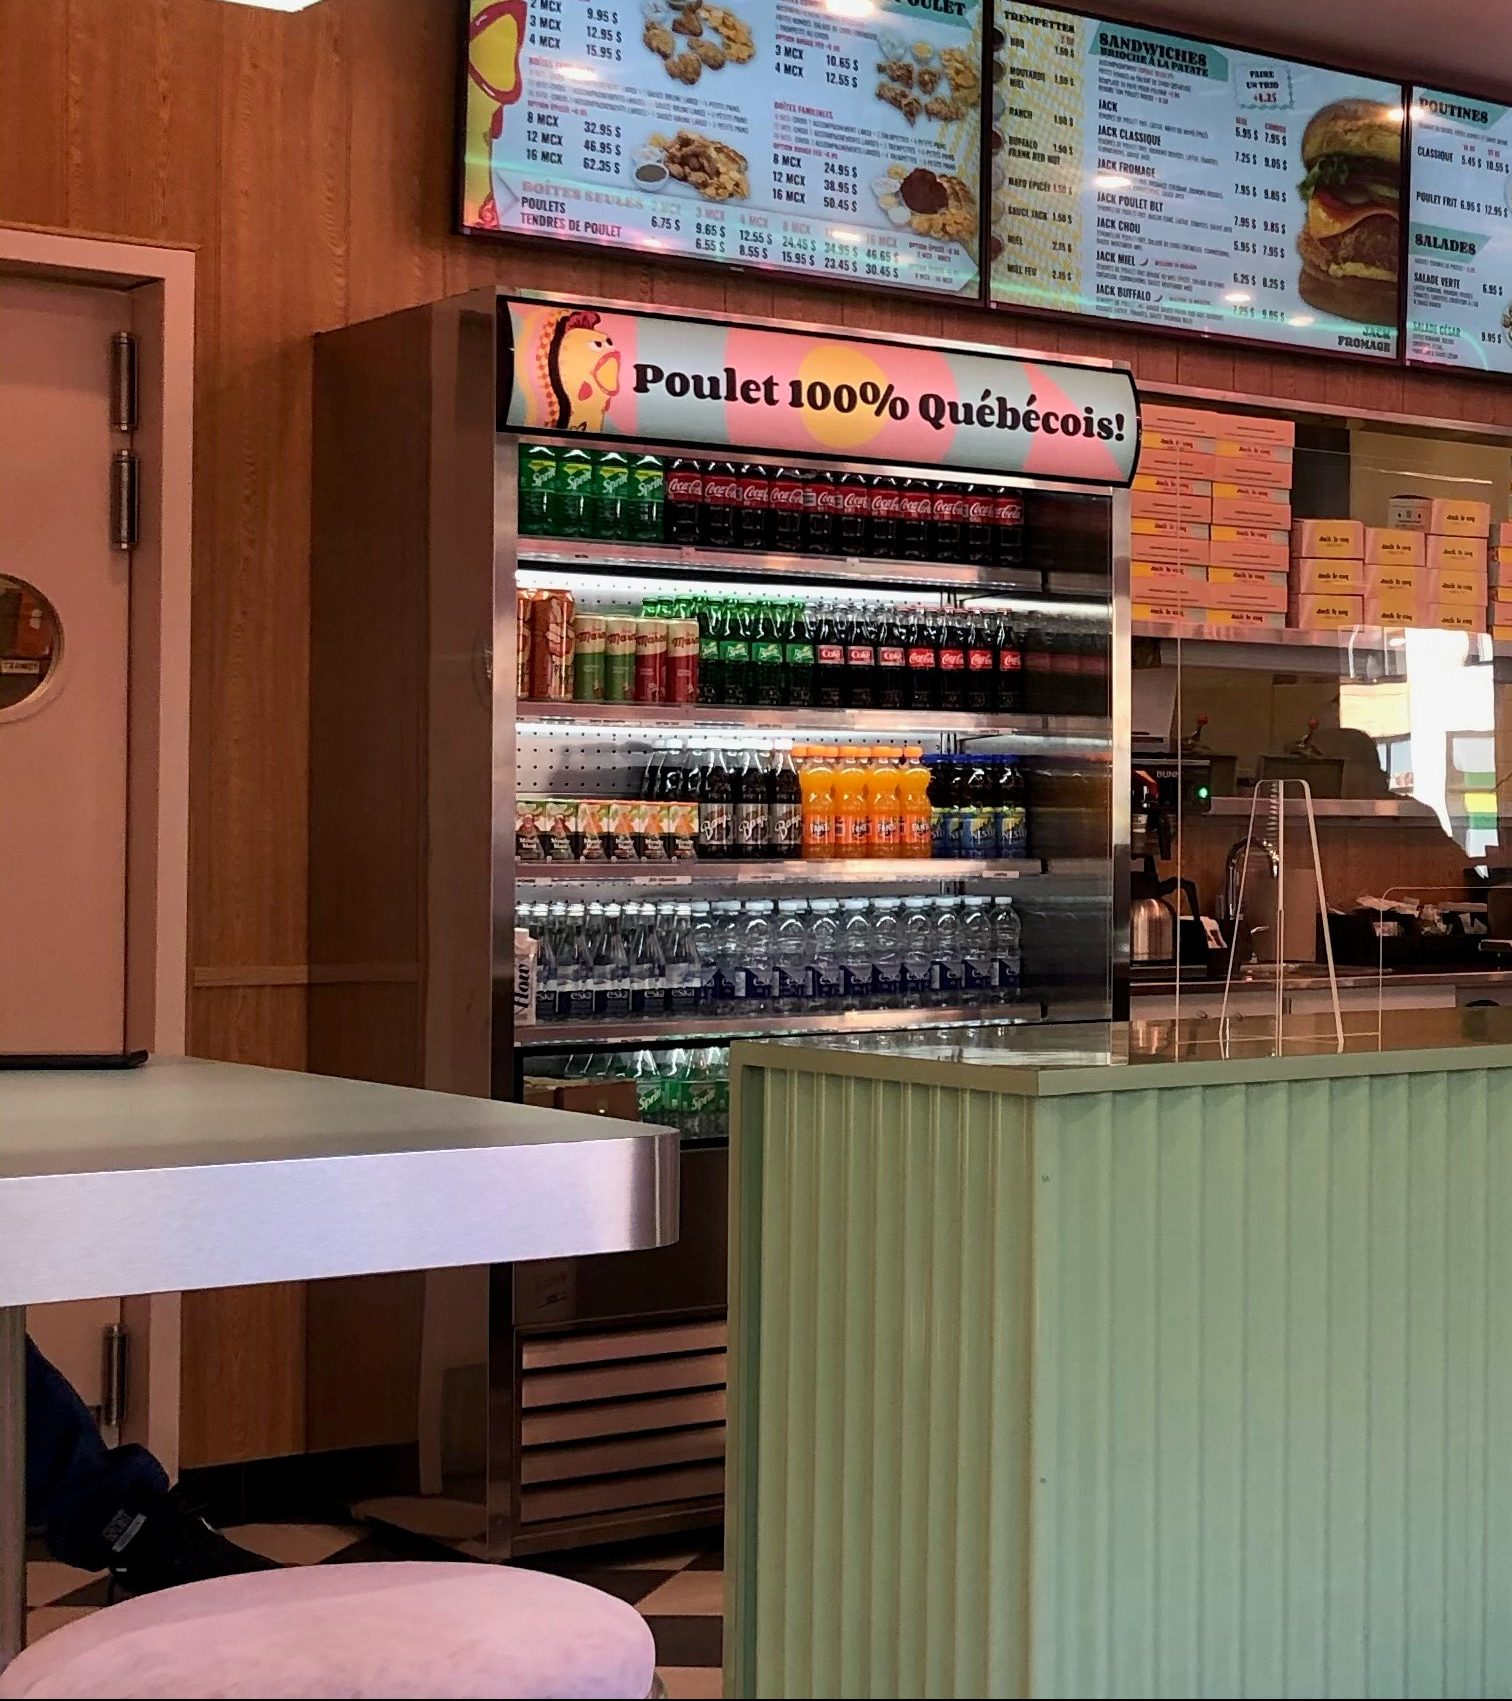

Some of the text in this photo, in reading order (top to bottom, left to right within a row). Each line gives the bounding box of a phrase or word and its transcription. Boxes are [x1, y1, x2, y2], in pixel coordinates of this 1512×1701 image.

[587, 8, 618, 24] 9.95 $
[1004, 10, 1075, 33] TREMPETTES
[529, 15, 622, 43] 3 MCX 12.95 $
[529, 34, 622, 61] 4 MCX 15.95 $
[776, 45, 859, 71] 3 MCX 10.65 $
[1100, 32, 1207, 66] SANDWICHES
[775, 62, 858, 89] 4 MCX 12.55 $
[1157, 58, 1170, 69] LA
[1171, 61, 1209, 77] PATATE
[1098, 99, 1118, 112] JACK
[1419, 97, 1488, 124] POUTINES
[528, 112, 622, 138] 8 MCX 32.95 $
[1098, 125, 1117, 139] JACK
[1119, 129, 1161, 146] CLASSIQUE
[527, 130, 621, 156] 12 MCX 46.95 $
[1417, 145, 1453, 163] CLASSIQUE
[526, 148, 621, 174] 16 MCX 62.35 $
[773, 154, 858, 179] 8 MCX 24.95 $
[1097, 158, 1156, 178] JACK FROMAGE
[773, 171, 858, 196] 12 MCX 38.95 $
[521, 196, 566, 214] POULETS
[651, 215, 672, 229] 6.75
[773, 188, 858, 213] 16 MCX 50.45 $
[1097, 192, 1163, 212] JACK POULET BLT
[520, 212, 623, 238] TENDRES DE POULET
[1096, 217, 1116, 230] JACK
[1118, 219, 1141, 233] CHOU
[1415, 233, 1476, 256] SALADES
[1096, 250, 1135, 266] JACK MIEL
[1096, 284, 1151, 302] JACK BUFFALO
[1413, 272, 1460, 290] SALADE VERTE
[633, 363, 1125, 442] Poulet 100% Québécois!
